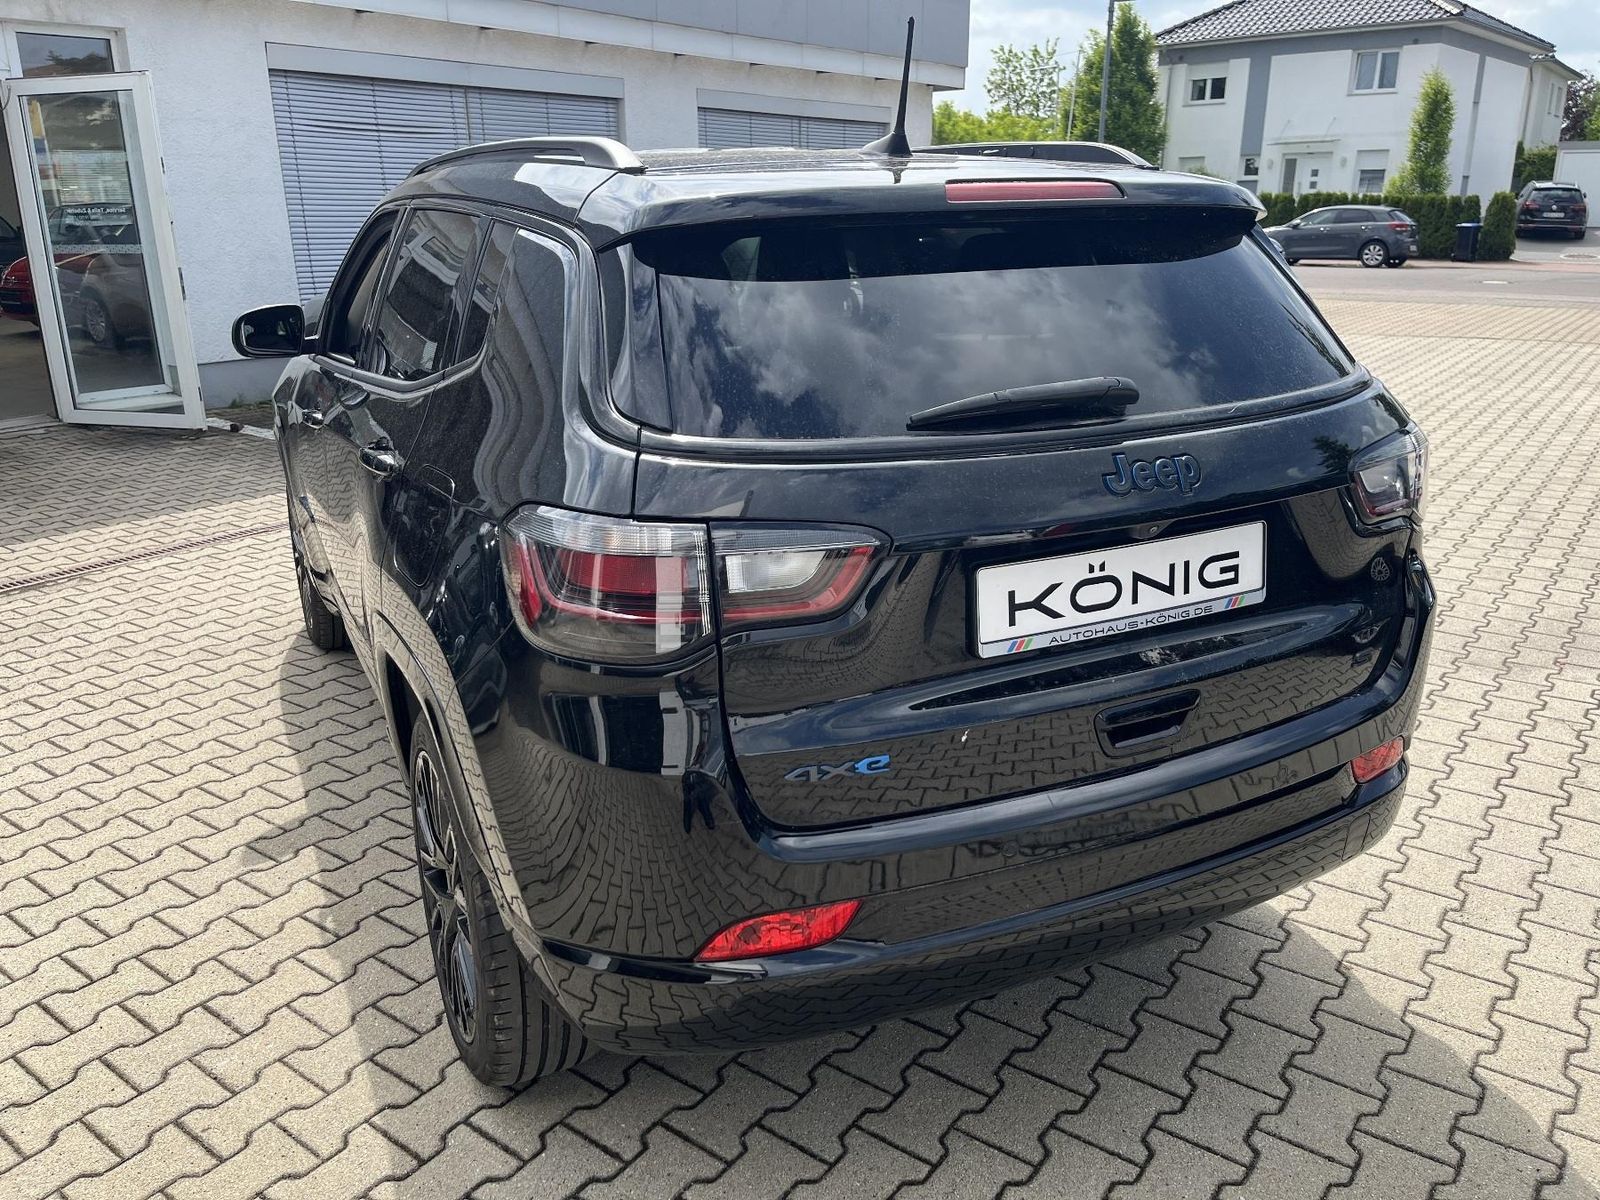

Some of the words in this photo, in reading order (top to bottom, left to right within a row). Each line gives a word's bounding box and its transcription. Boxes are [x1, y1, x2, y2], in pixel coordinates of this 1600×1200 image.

[1102, 453, 1203, 496] Jeep
[1008, 550, 1240, 627] KÖNIG
[1049, 604, 1213, 645] AUTOHAUS-KÖNIG.DE
